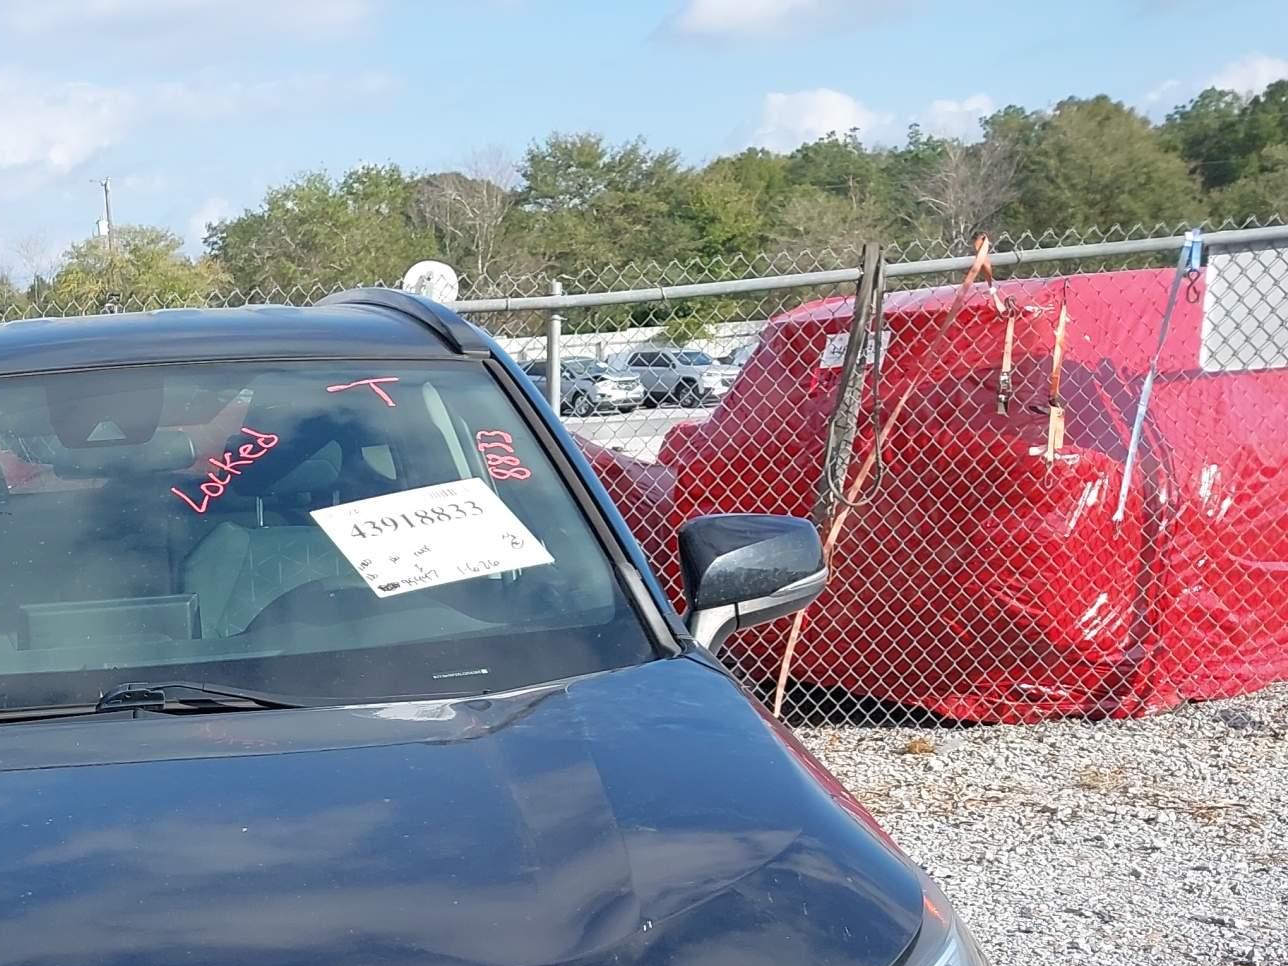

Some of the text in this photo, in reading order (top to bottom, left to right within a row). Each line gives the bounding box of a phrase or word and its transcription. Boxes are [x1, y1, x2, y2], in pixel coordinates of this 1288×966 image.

[326, 377, 400, 407] T
[171, 427, 279, 514] Locked
[476, 430, 532, 480] 8833
[351, 501, 484, 539] 43918833
